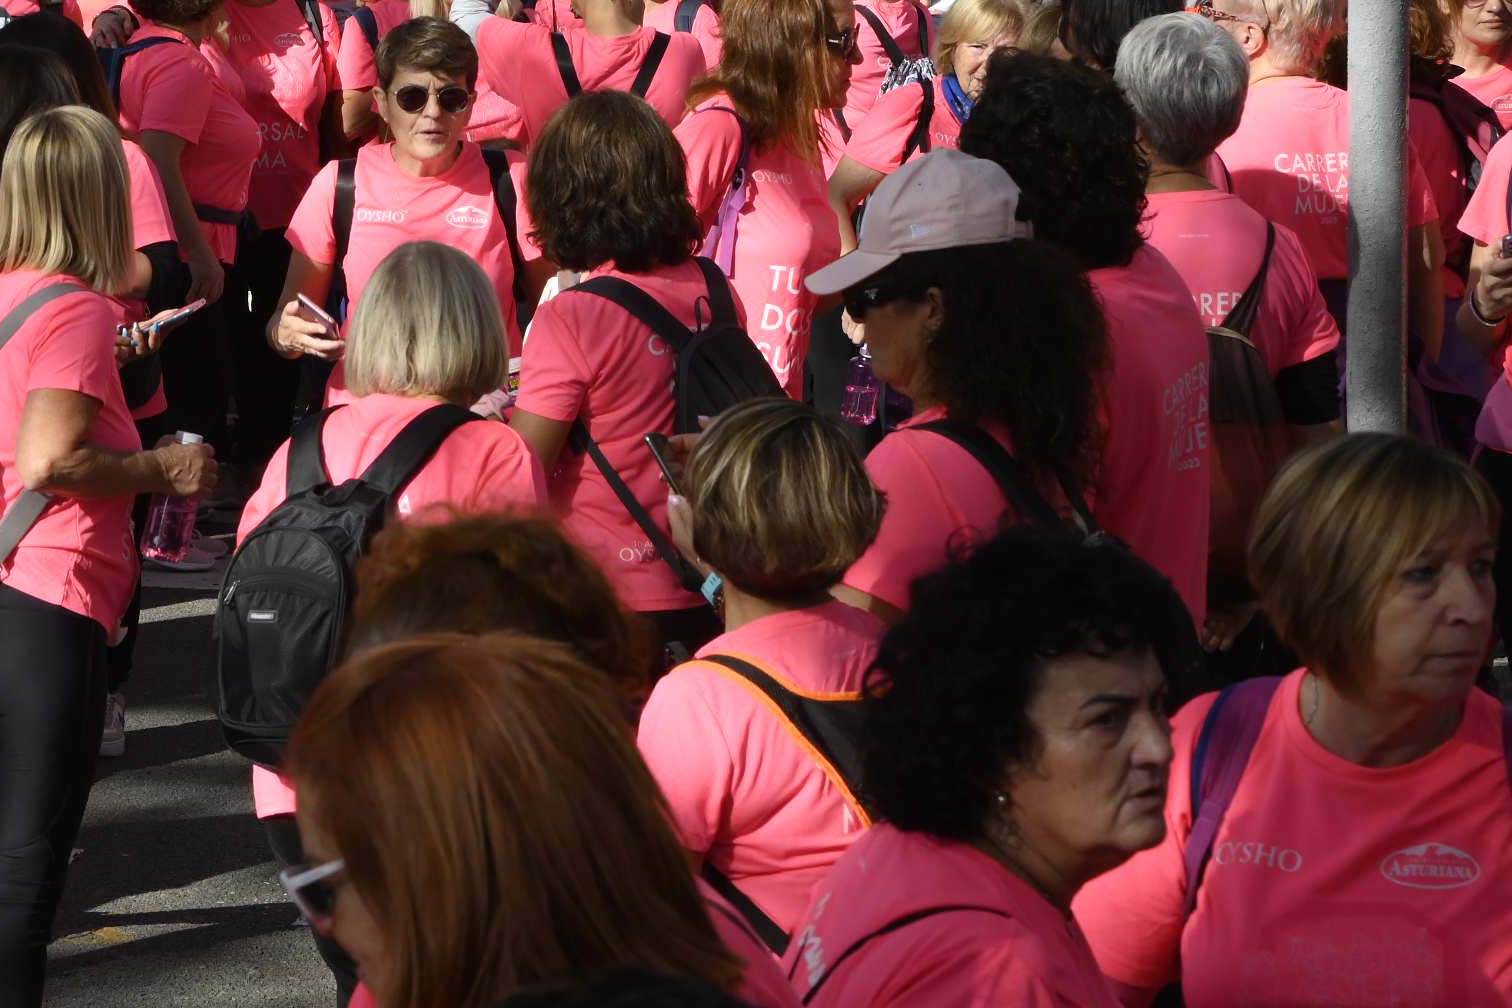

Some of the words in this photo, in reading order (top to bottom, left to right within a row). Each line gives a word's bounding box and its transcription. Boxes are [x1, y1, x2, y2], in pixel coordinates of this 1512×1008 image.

[258, 122, 304, 141] RSAL
[935, 132, 958, 146] OYS
[258, 150, 287, 168] MA
[1274, 153, 1349, 173] CARRER
[1297, 174, 1322, 193] DE
[1295, 194, 1349, 214] MUJE
[356, 209, 405, 223] OYSHO
[769, 265, 806, 294] TU
[1163, 361, 1208, 413] CARRER
[1168, 422, 1208, 462] MUJE
[619, 547, 654, 563] OYS
[1215, 842, 1303, 872] OYSHO
[1391, 860, 1474, 879] ASTURIANA
